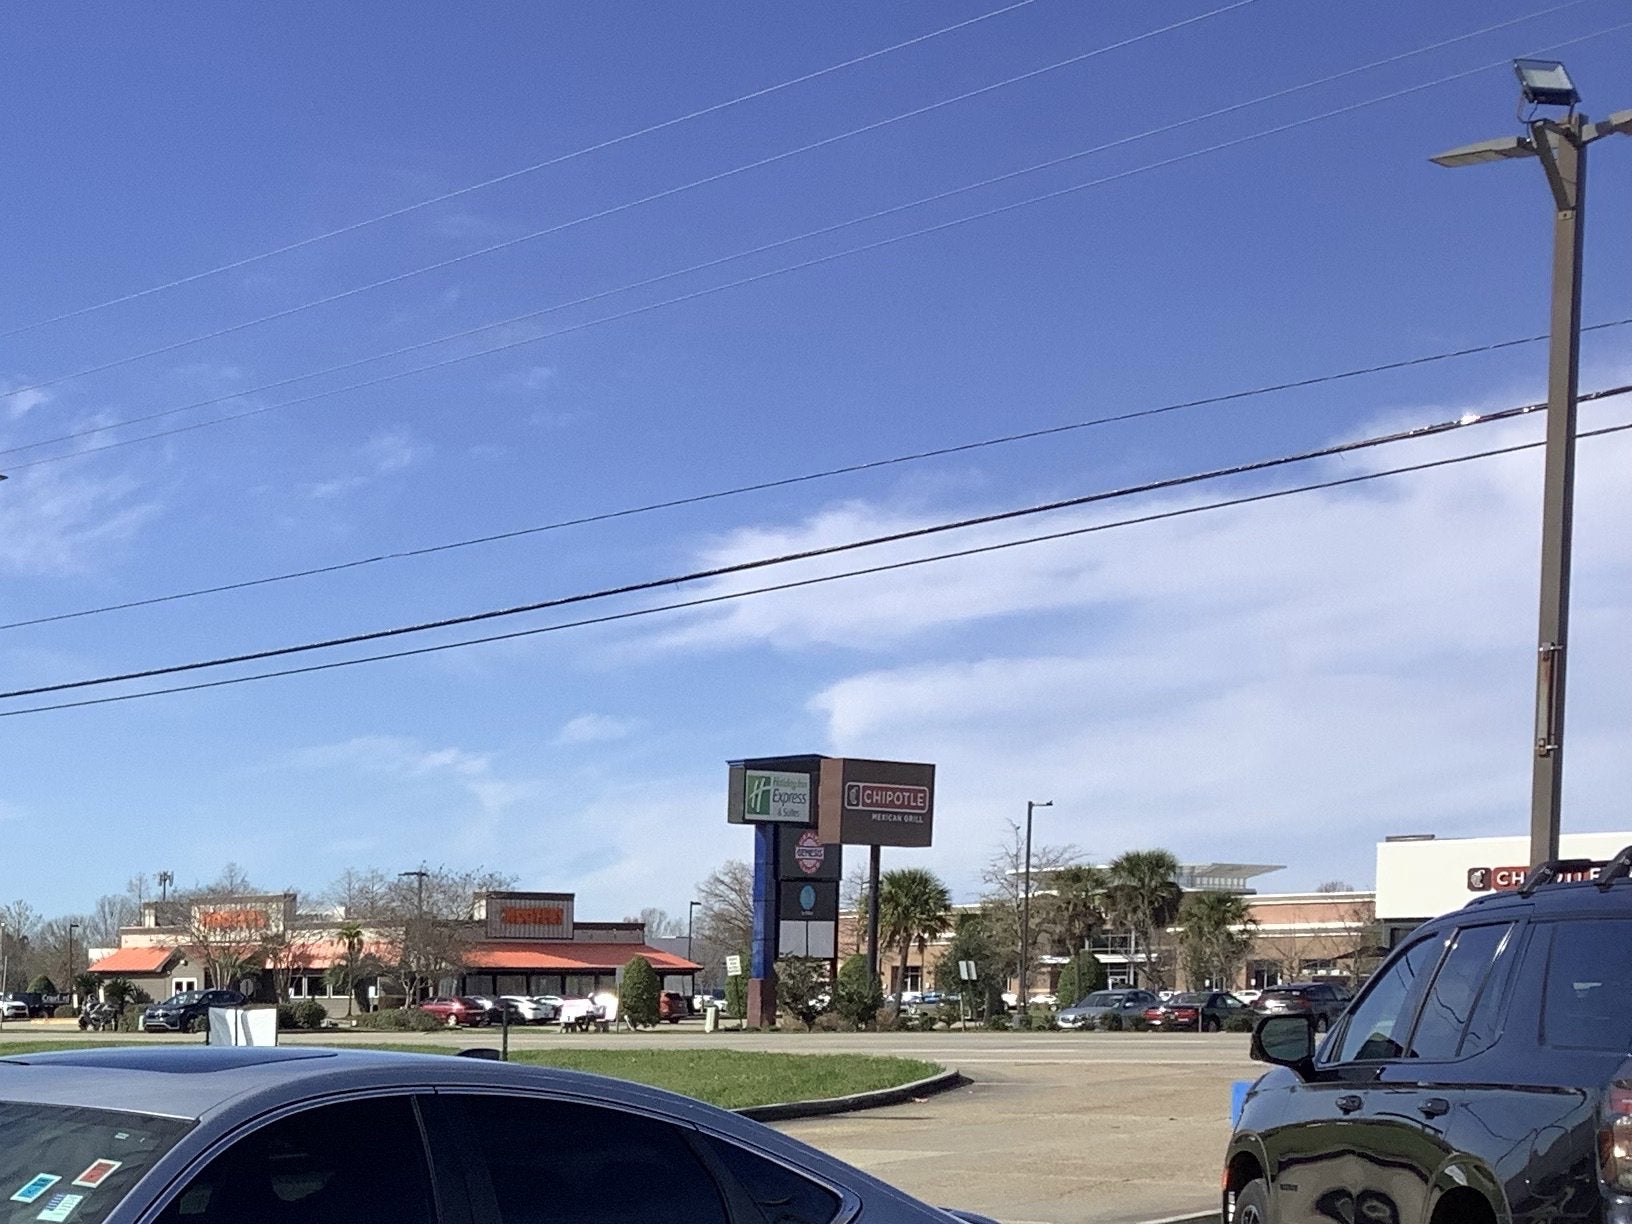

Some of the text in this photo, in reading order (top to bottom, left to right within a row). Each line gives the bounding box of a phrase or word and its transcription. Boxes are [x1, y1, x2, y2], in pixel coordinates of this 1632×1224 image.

[773, 788, 807, 806] Express
[864, 789, 925, 807] CHIPOTLE
[872, 813, 924, 823] MEXICAN GRILL
